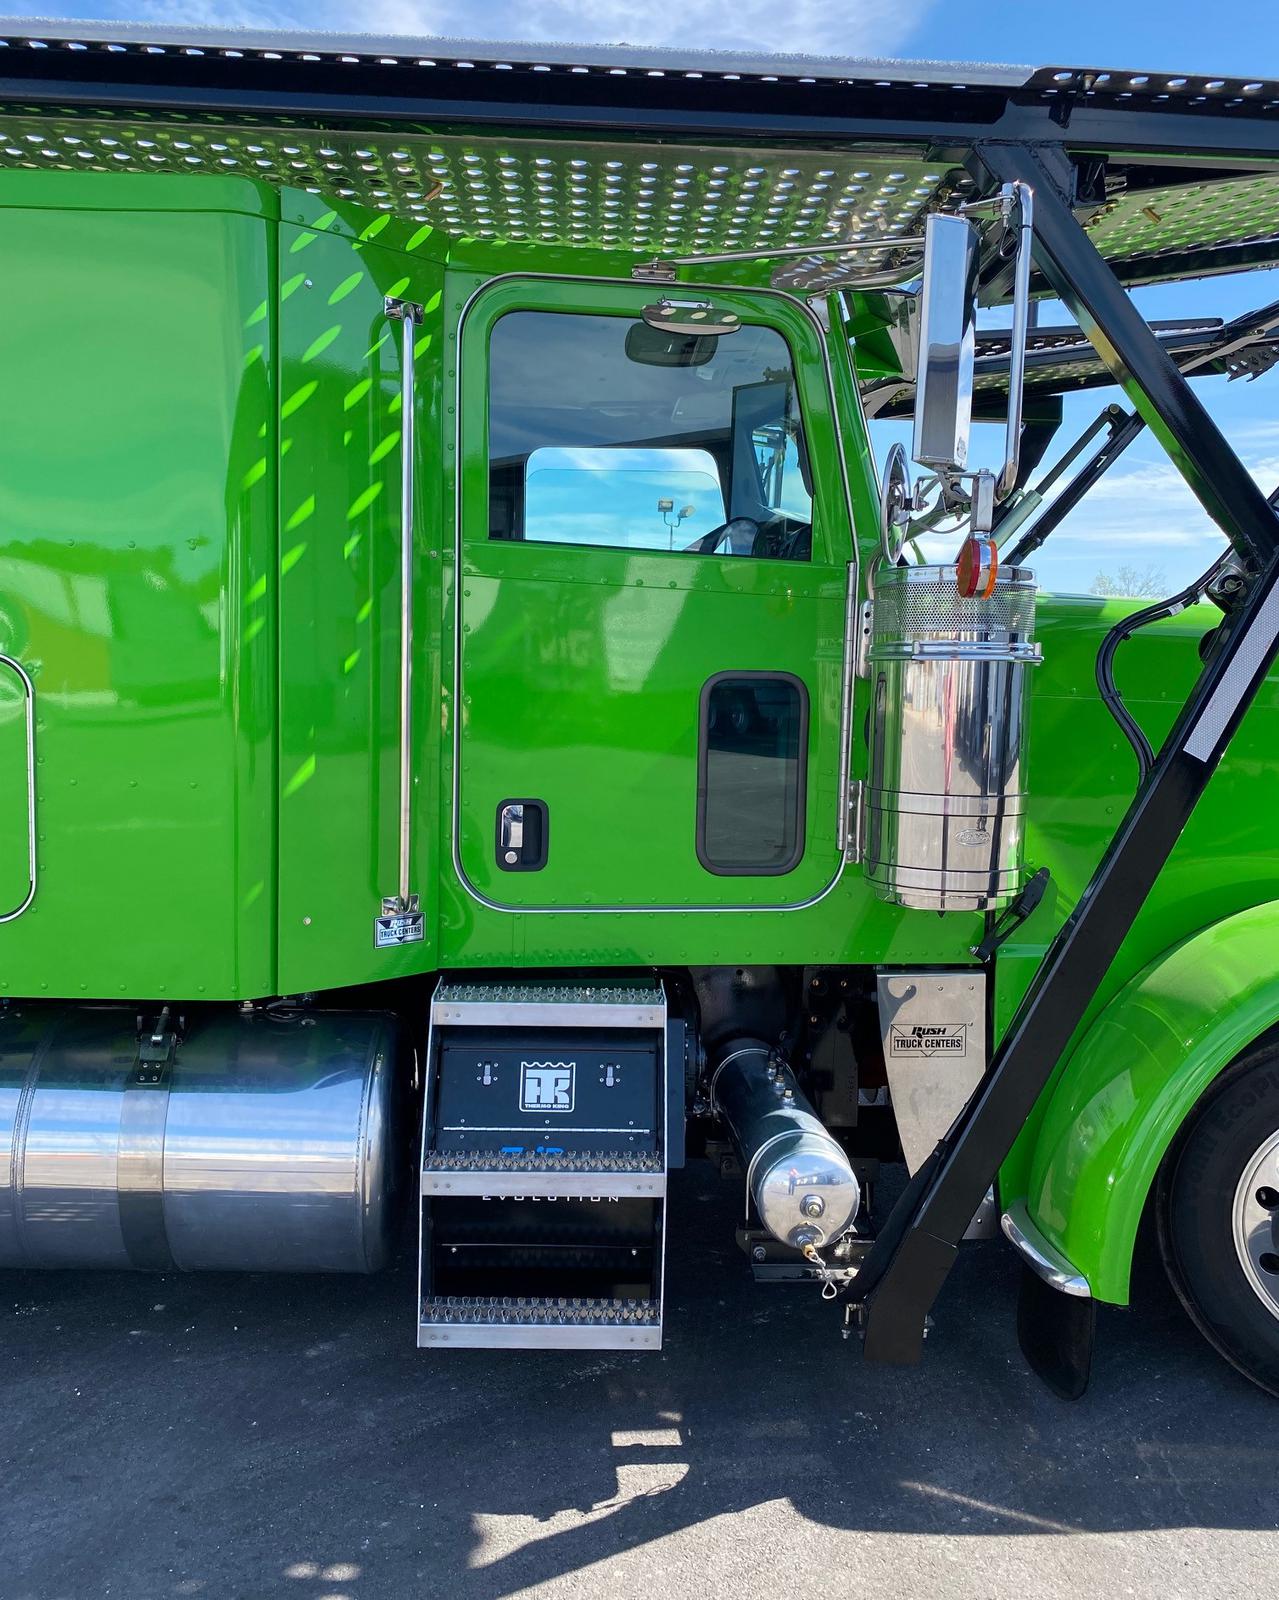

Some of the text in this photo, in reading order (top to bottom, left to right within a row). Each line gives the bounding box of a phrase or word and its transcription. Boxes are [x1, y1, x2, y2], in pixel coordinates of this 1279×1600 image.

[381, 925, 421, 937] TRUCK CENTERS
[911, 1027, 947, 1039] RUSH
[895, 1039, 961, 1048] TRUCK CENTERS
